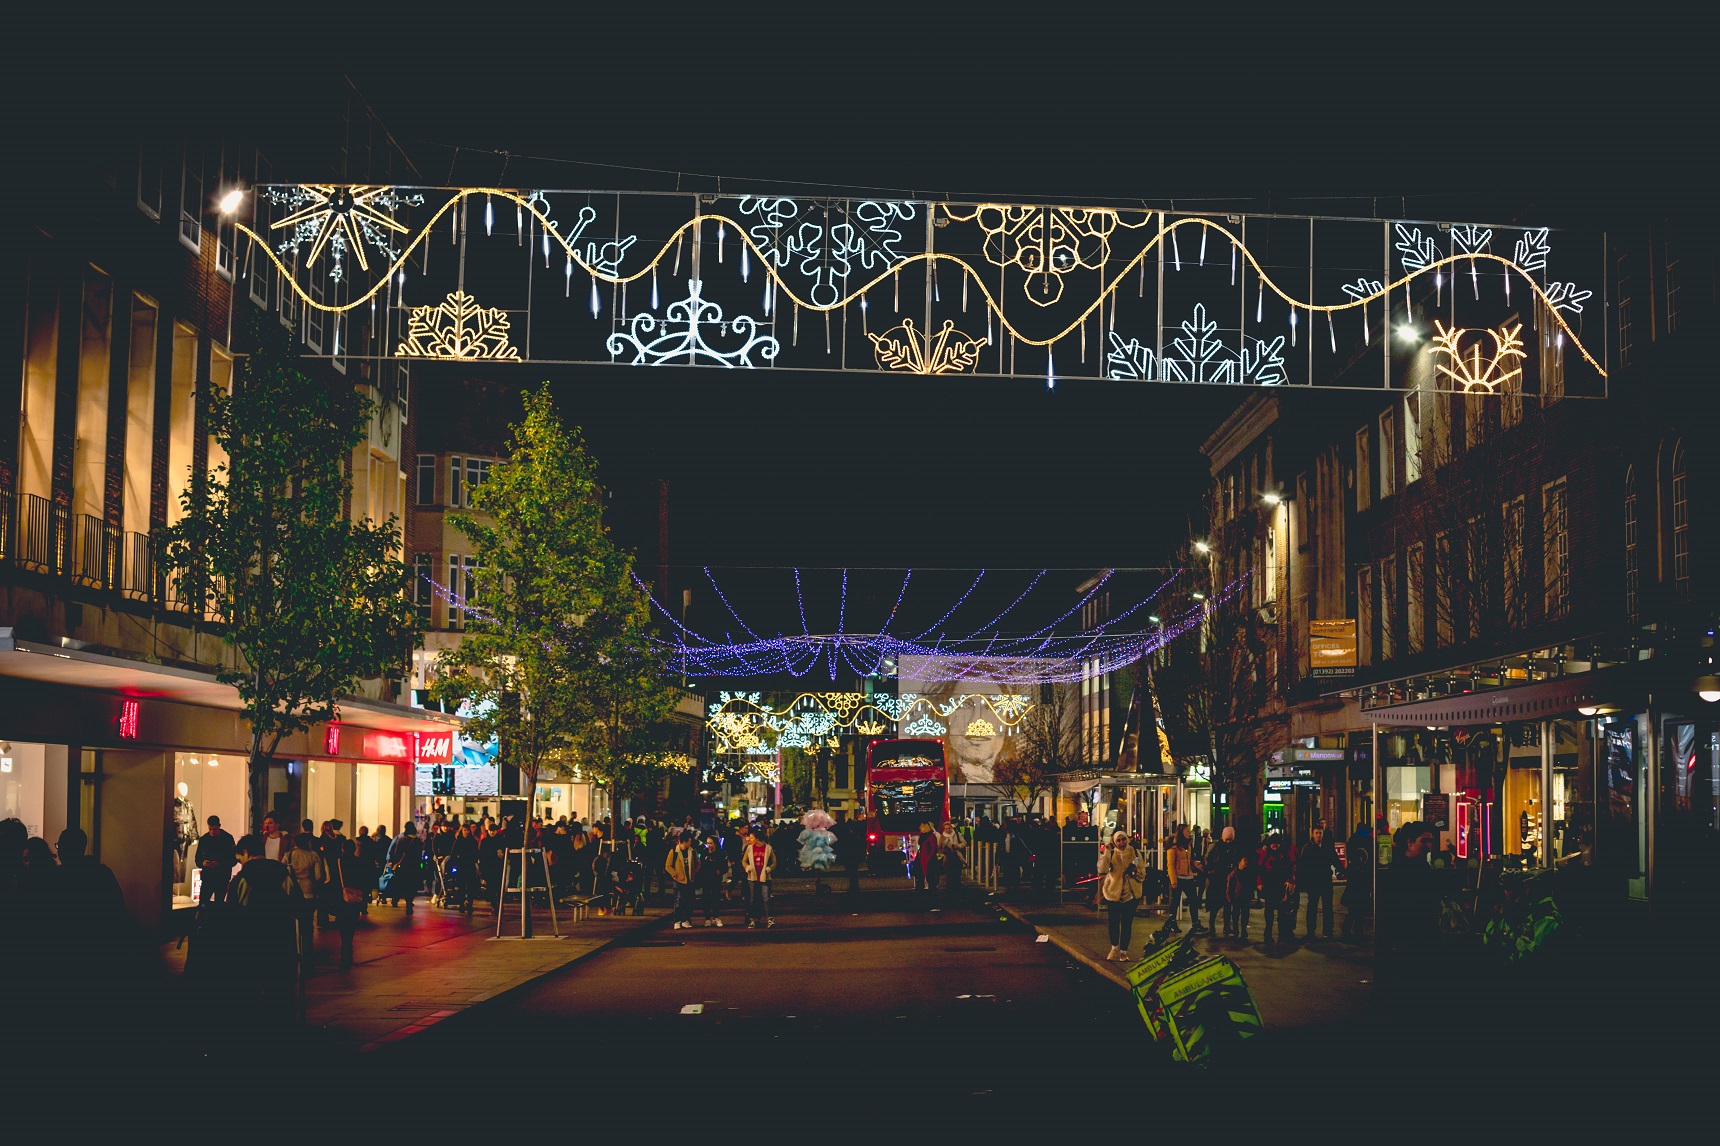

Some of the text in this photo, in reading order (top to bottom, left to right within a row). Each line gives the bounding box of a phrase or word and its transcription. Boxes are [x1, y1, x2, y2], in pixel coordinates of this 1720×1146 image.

[421, 737, 450, 758] H&M
[1137, 952, 1175, 978] AMBULANC
[1173, 970, 1224, 998] AMBULANCE
